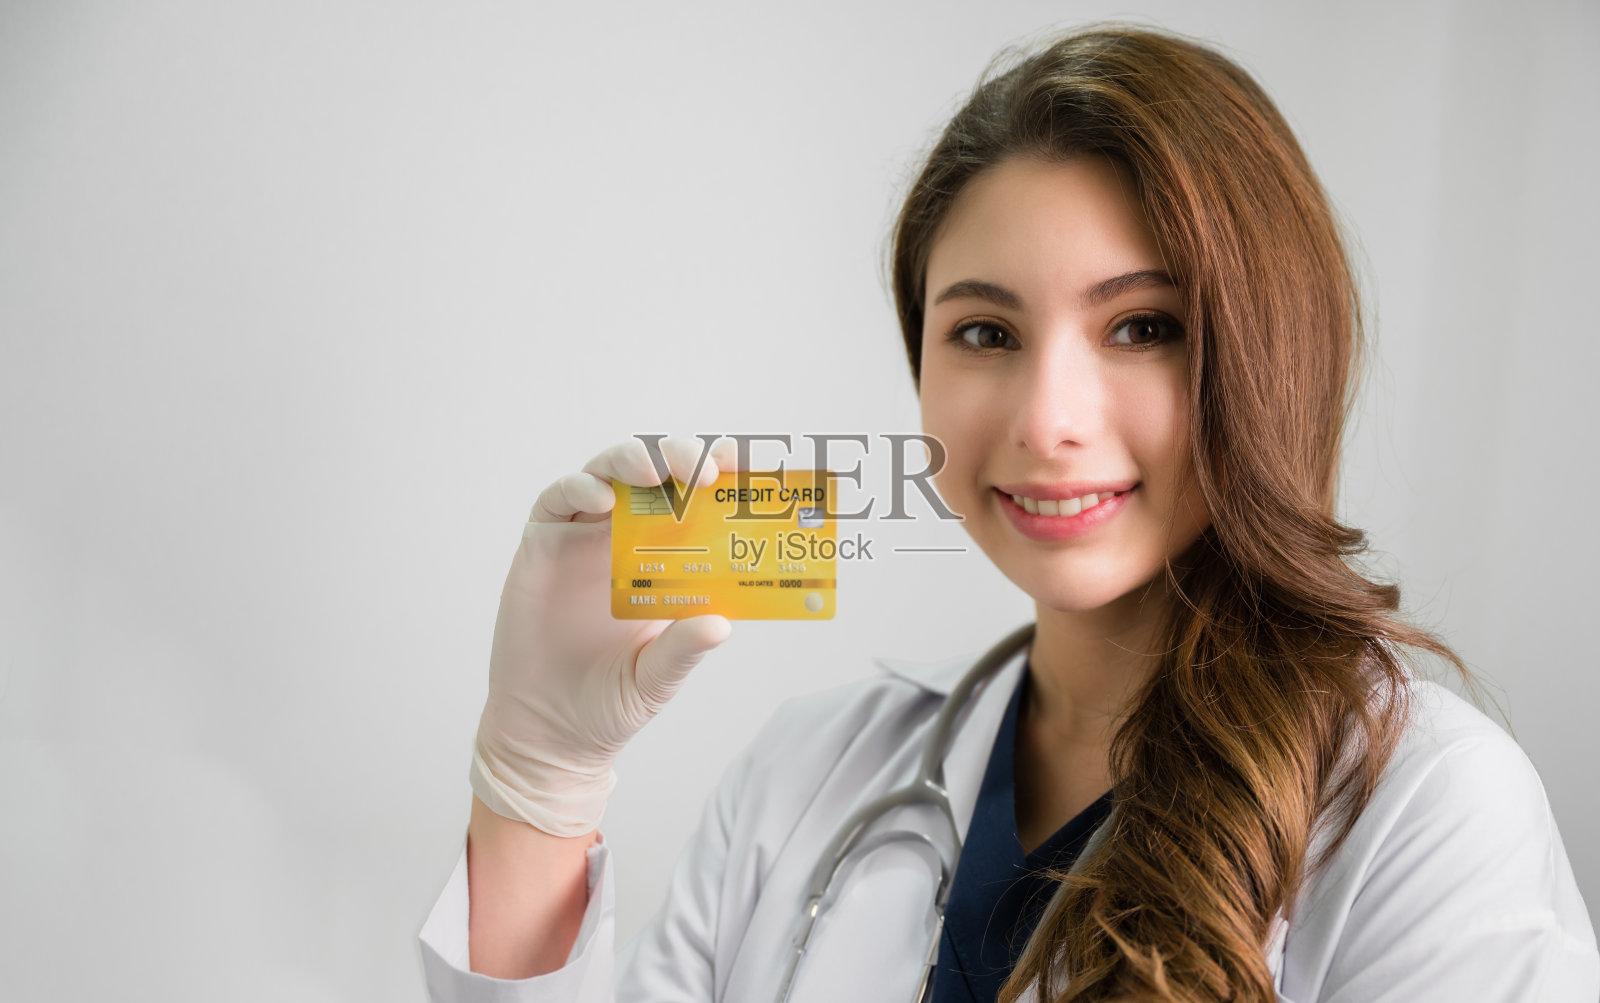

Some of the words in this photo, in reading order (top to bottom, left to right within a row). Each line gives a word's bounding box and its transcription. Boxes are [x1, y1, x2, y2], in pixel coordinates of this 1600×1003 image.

[715, 488, 774, 502] CREDIT
[779, 488, 825, 502] CARD
[639, 563, 665, 573] 1234
[683, 563, 711, 573] 5678
[632, 579, 652, 588] 0000
[779, 579, 802, 588] 00/00
[631, 595, 657, 605] NAME
[664, 595, 711, 605] SURNAME
